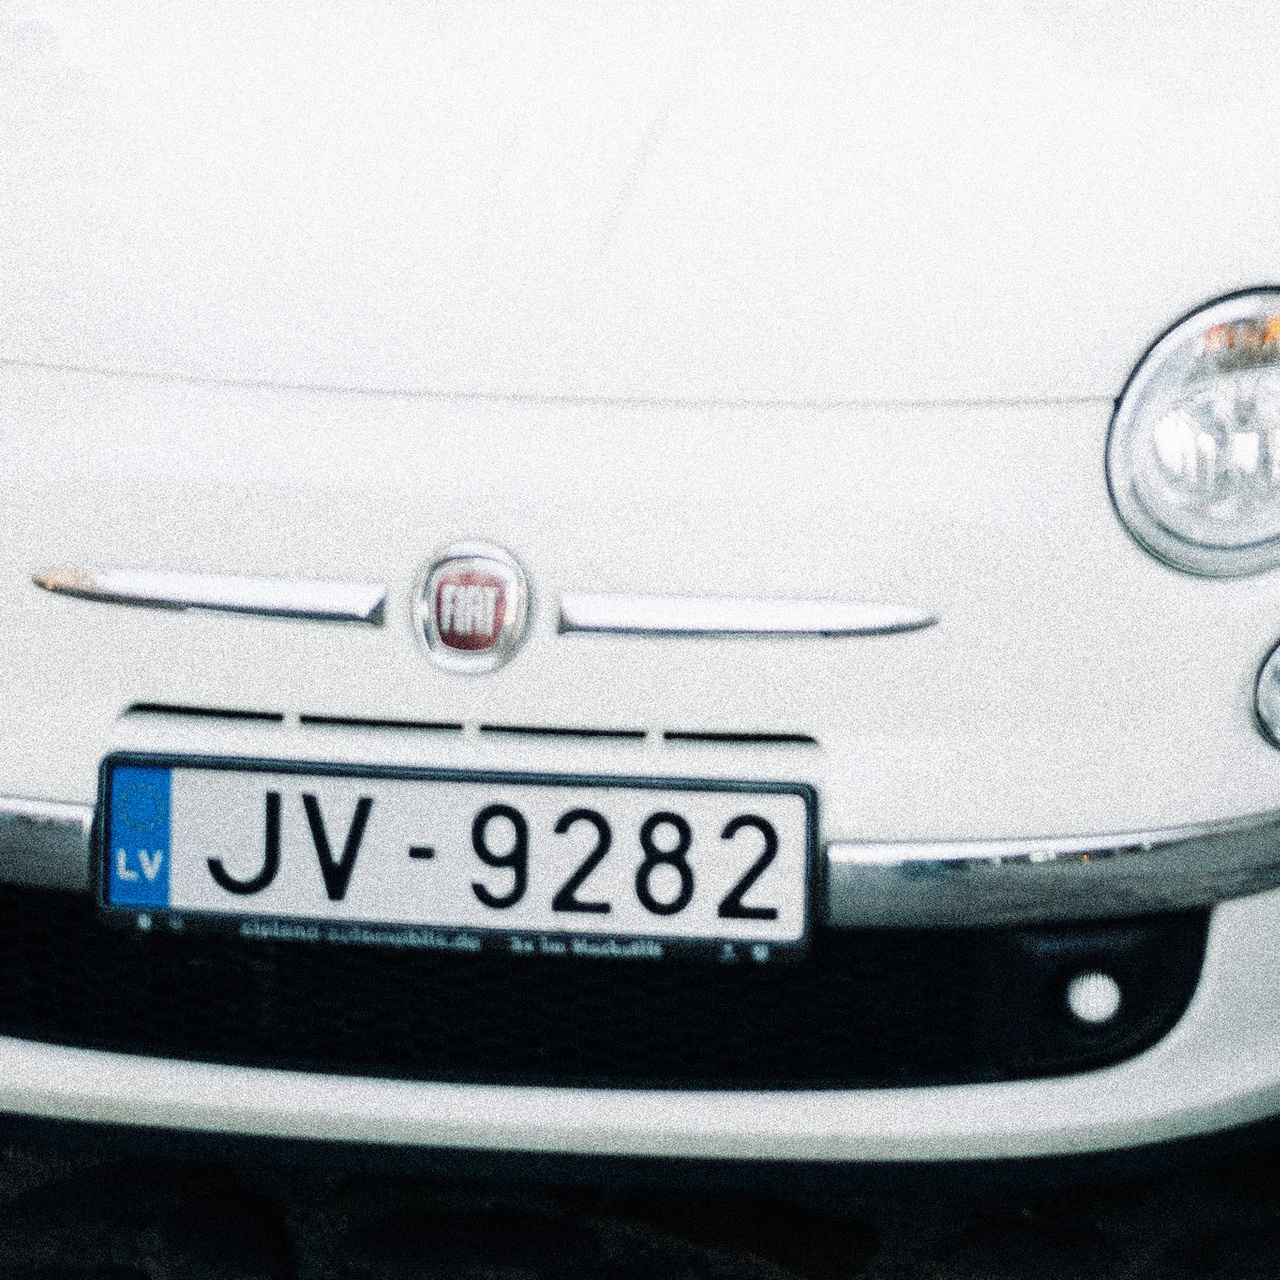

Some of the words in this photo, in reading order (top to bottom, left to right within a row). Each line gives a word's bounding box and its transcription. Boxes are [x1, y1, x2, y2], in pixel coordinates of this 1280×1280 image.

[441, 584, 499, 636] FIAT
[116, 848, 164, 882] LV
[206, 791, 779, 921] JV-9282
